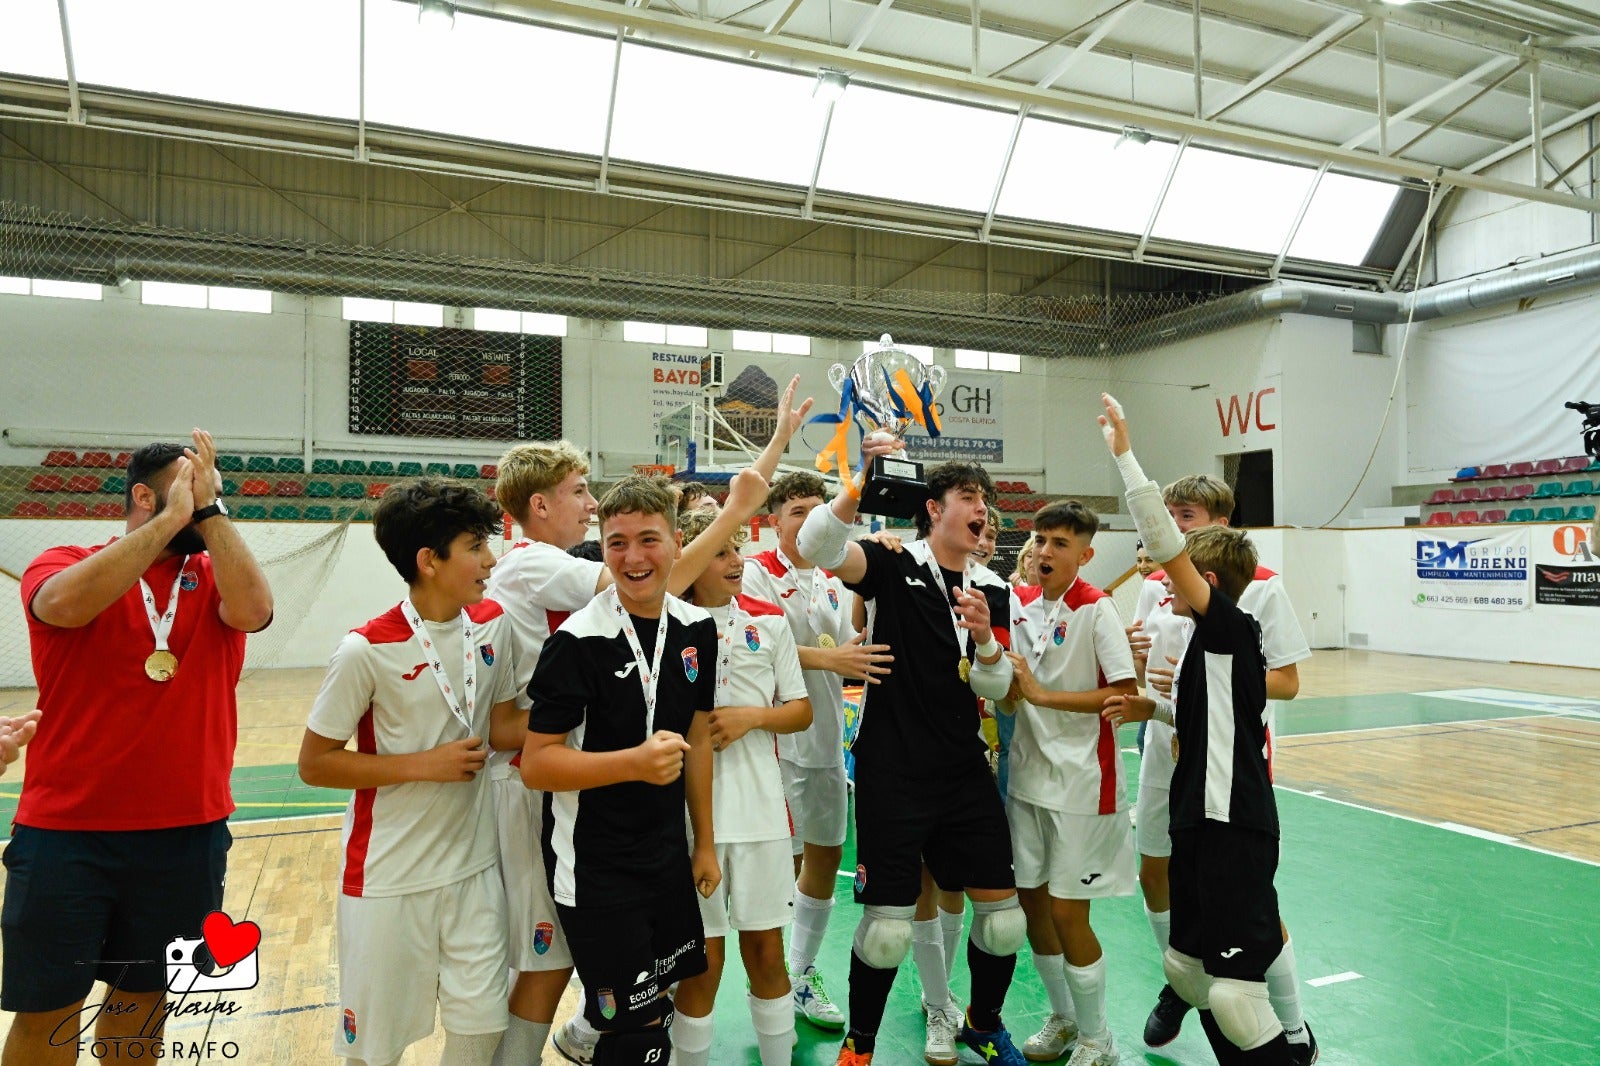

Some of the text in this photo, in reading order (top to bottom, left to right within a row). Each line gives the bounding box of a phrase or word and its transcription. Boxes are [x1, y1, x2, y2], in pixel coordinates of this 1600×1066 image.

[408, 347, 437, 357] LOCAL
[653, 352, 703, 364] RESTAUR
[653, 367, 701, 385] BAYD
[952, 385, 991, 414] GH
[1216, 388, 1276, 437] WC
[949, 416, 996, 425] COSTA BLANCA
[1470, 546, 1527, 556] GRUPO
[629, 990, 648, 1004] ECO
